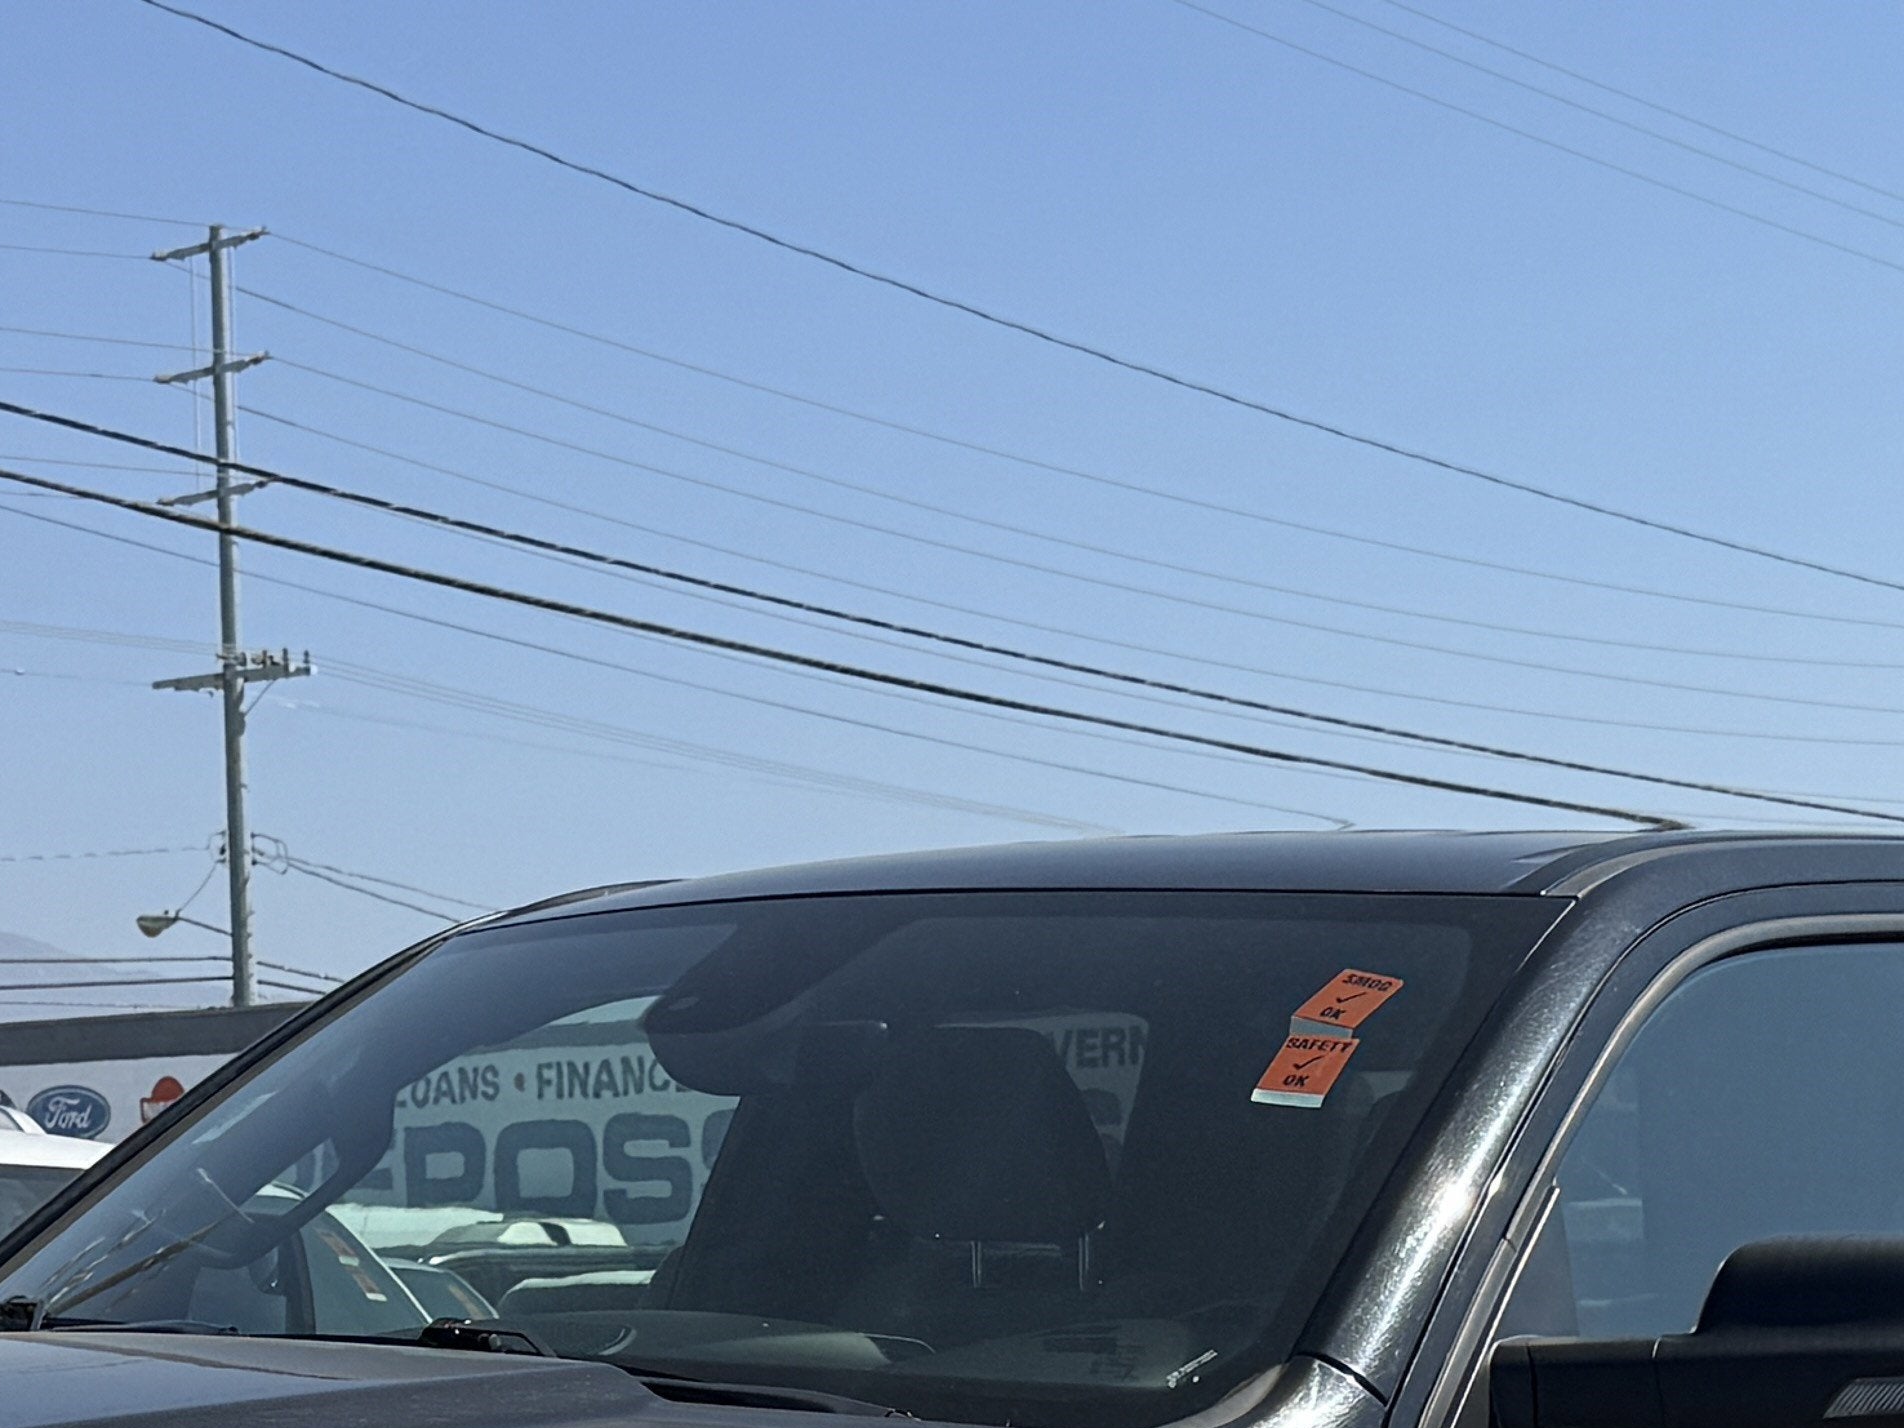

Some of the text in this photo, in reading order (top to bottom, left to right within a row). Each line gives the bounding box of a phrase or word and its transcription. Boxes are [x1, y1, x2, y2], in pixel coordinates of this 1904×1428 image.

[1319, 1007, 1346, 1021] OK
[397, 1056, 699, 1108] OANS FINANC
[1283, 1074, 1310, 1088] OK
[45, 1098, 92, 1130] Ford
